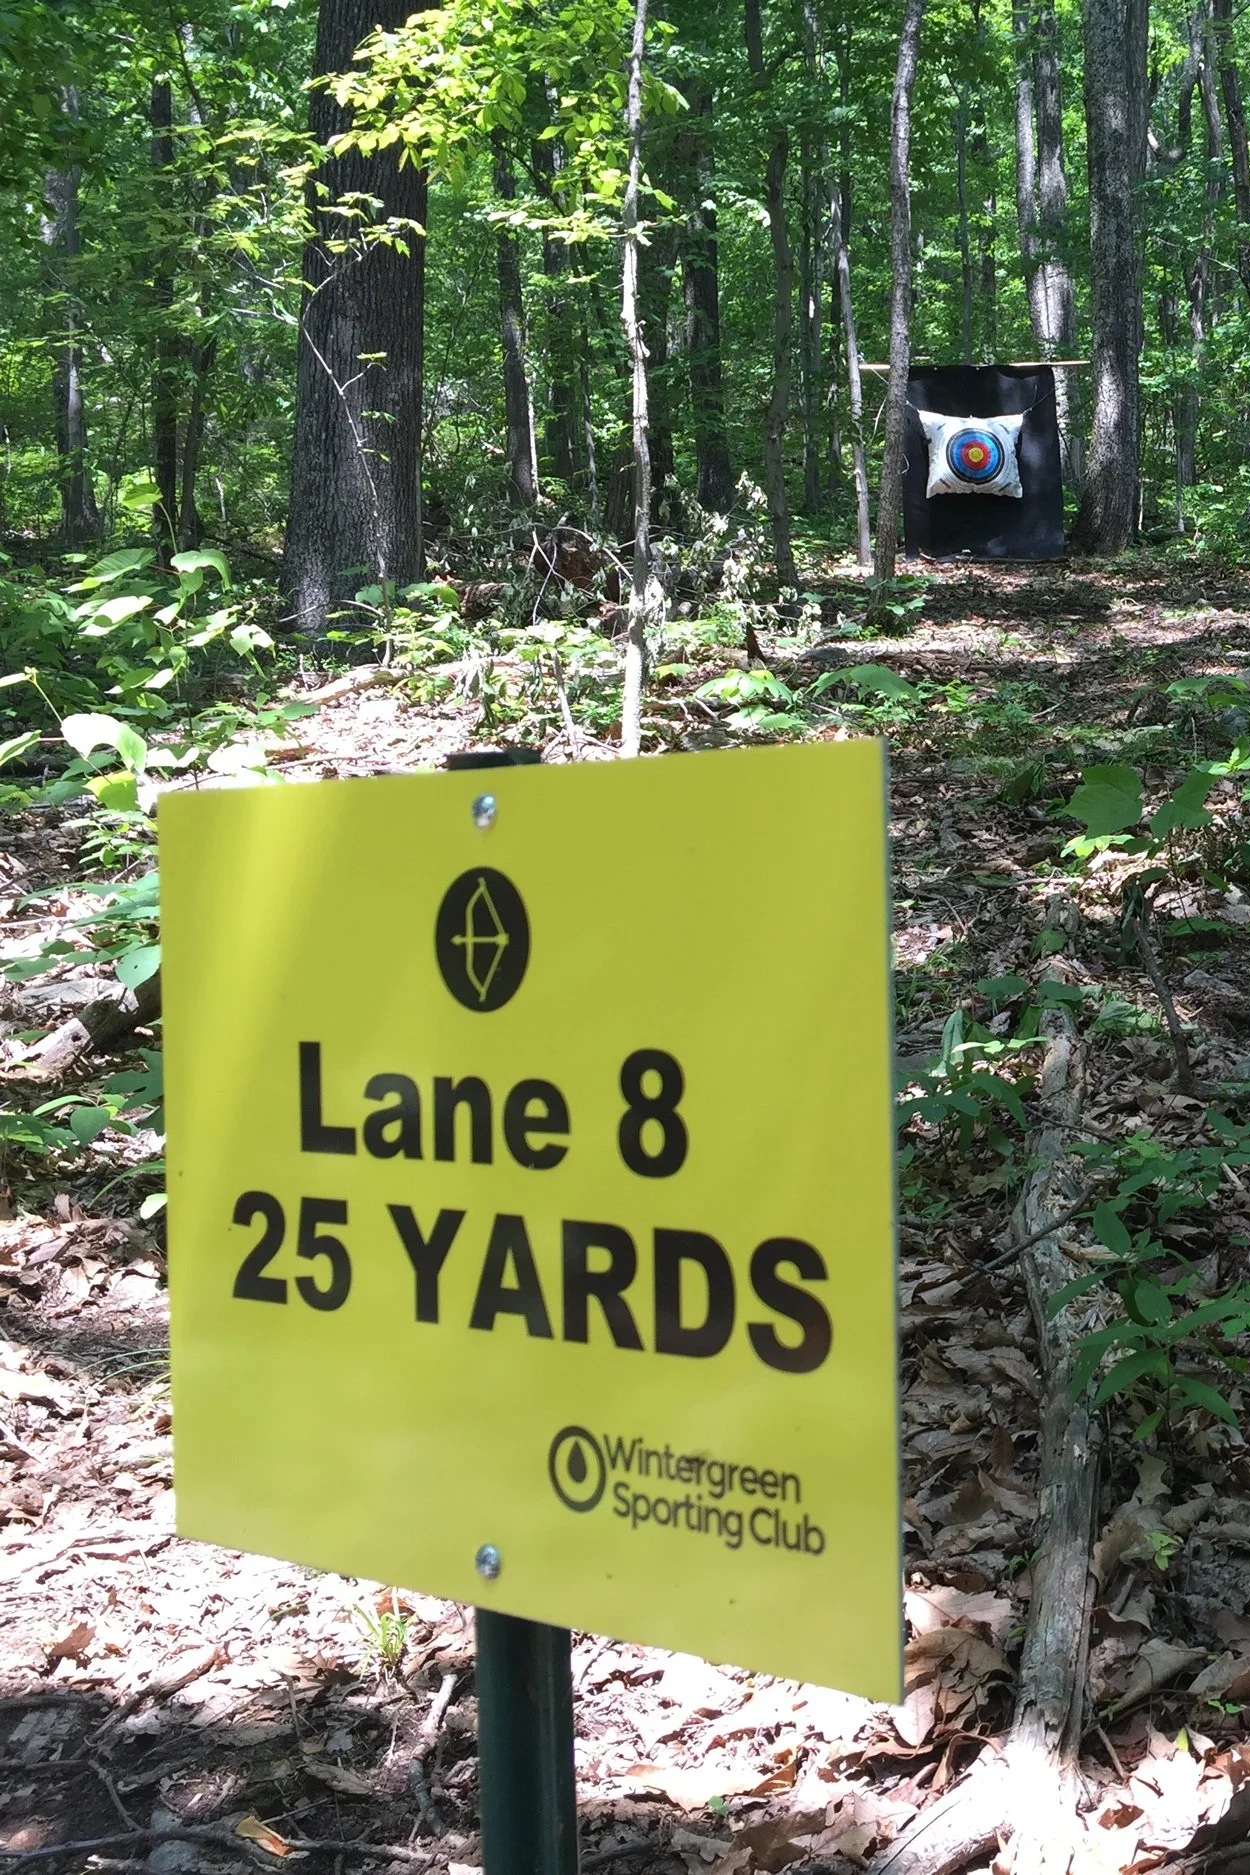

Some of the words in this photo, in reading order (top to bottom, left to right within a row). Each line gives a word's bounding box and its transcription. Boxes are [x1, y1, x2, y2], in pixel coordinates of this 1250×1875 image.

[298, 1041, 570, 1171] Lane
[618, 1048, 688, 1178] 8
[232, 1190, 352, 1312] 25
[387, 1203, 833, 1374] YARDS
[604, 1434, 802, 1503] Wintergreen
[613, 1482, 745, 1549] Sporting
[750, 1507, 826, 1555] Club
